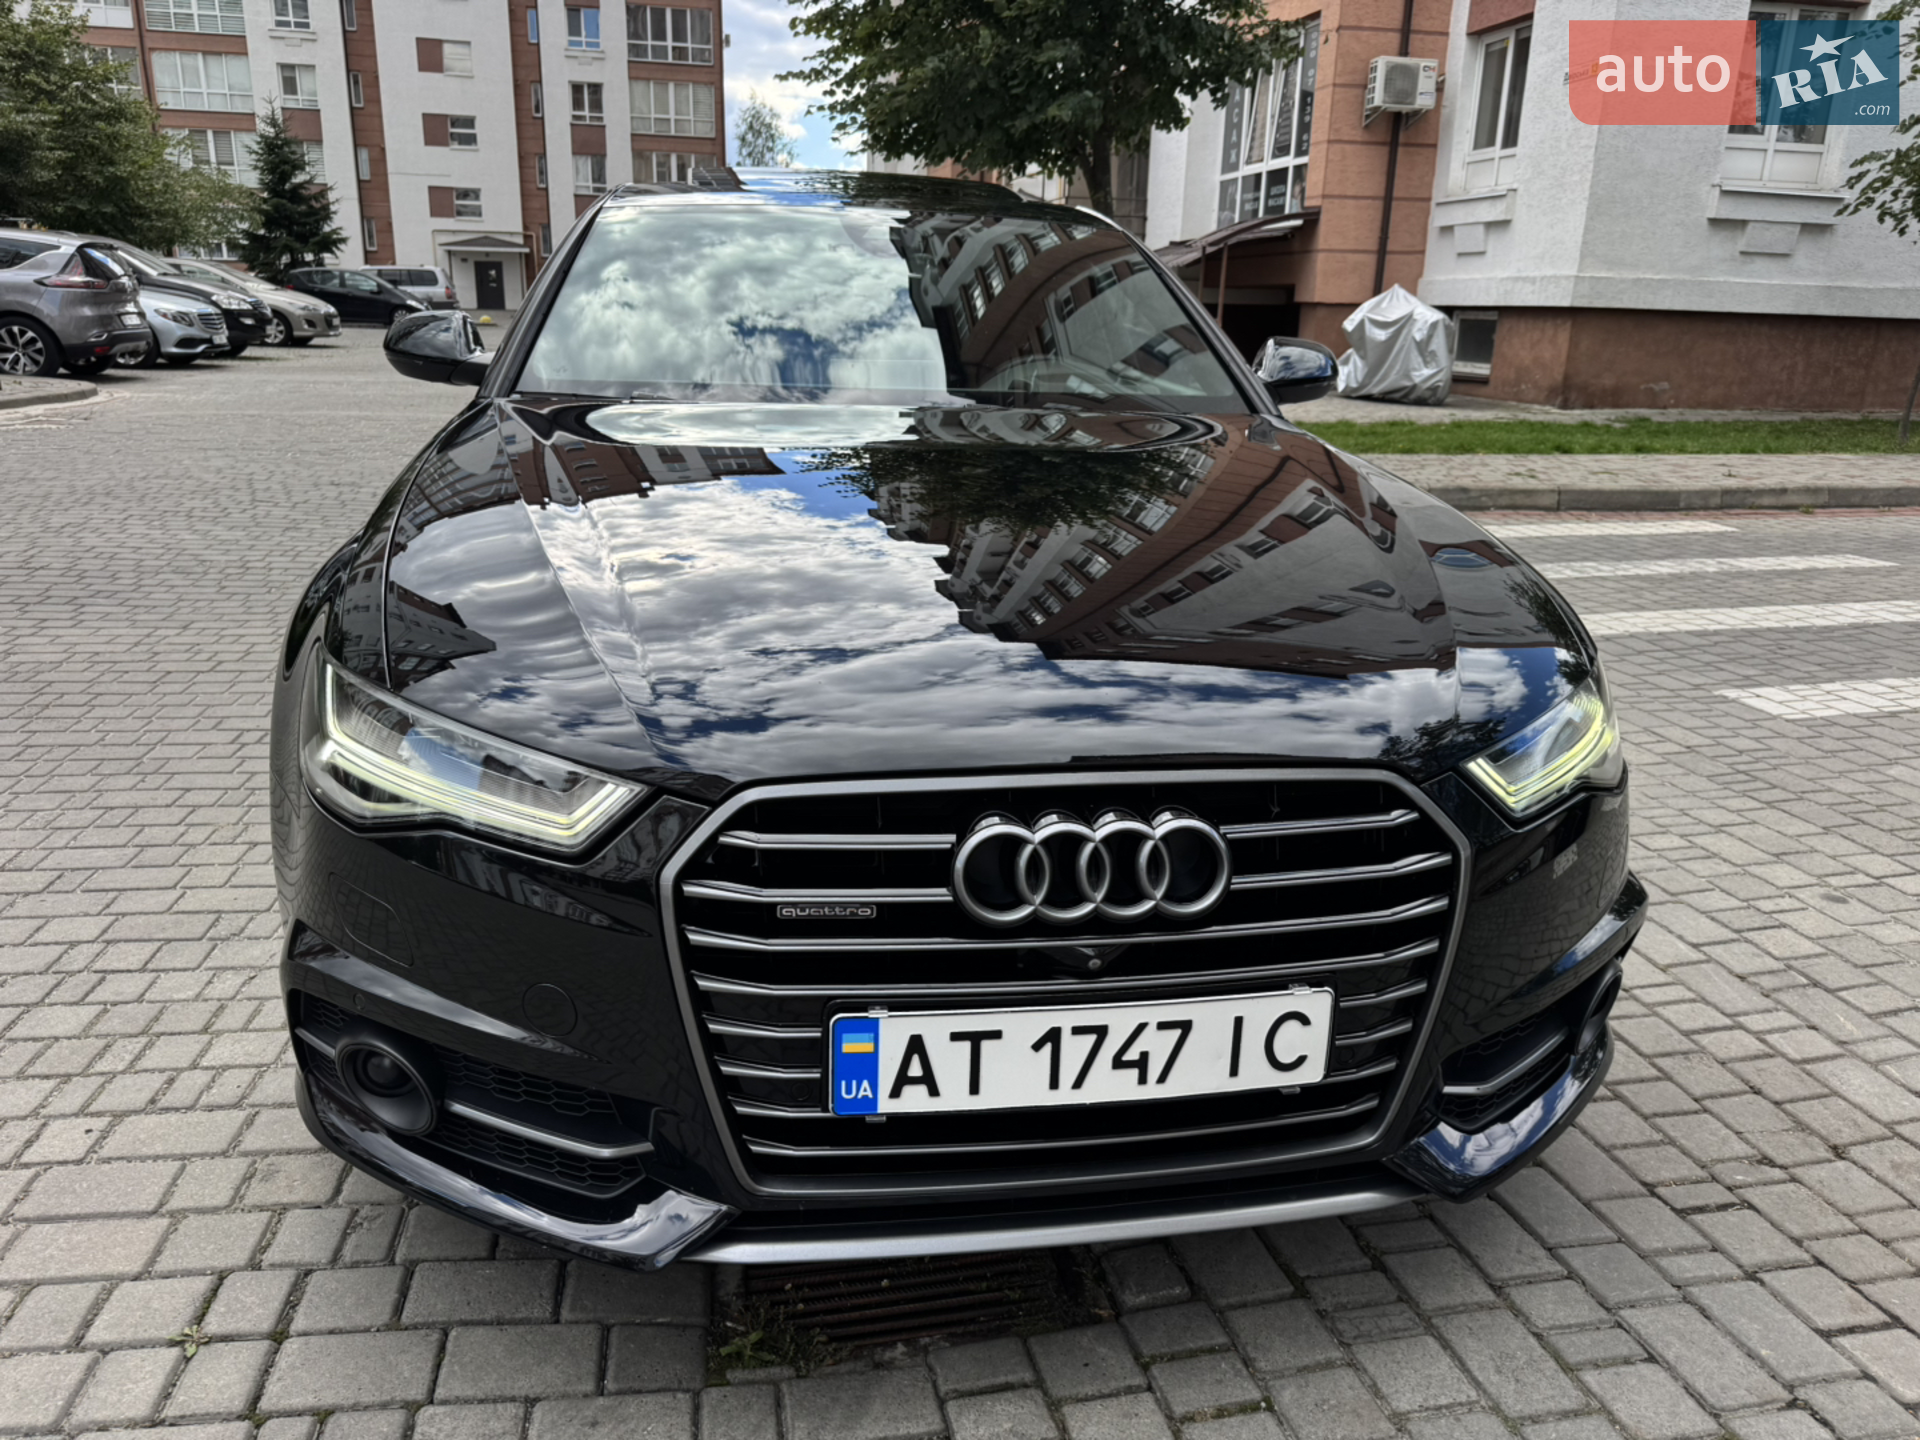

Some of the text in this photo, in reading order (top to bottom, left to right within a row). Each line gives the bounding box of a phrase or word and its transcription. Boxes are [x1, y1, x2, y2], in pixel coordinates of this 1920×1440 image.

[781, 906, 872, 918] quattro
[888, 1010, 1312, 1098] AT 1747 IC
[840, 1079, 873, 1099] UA
